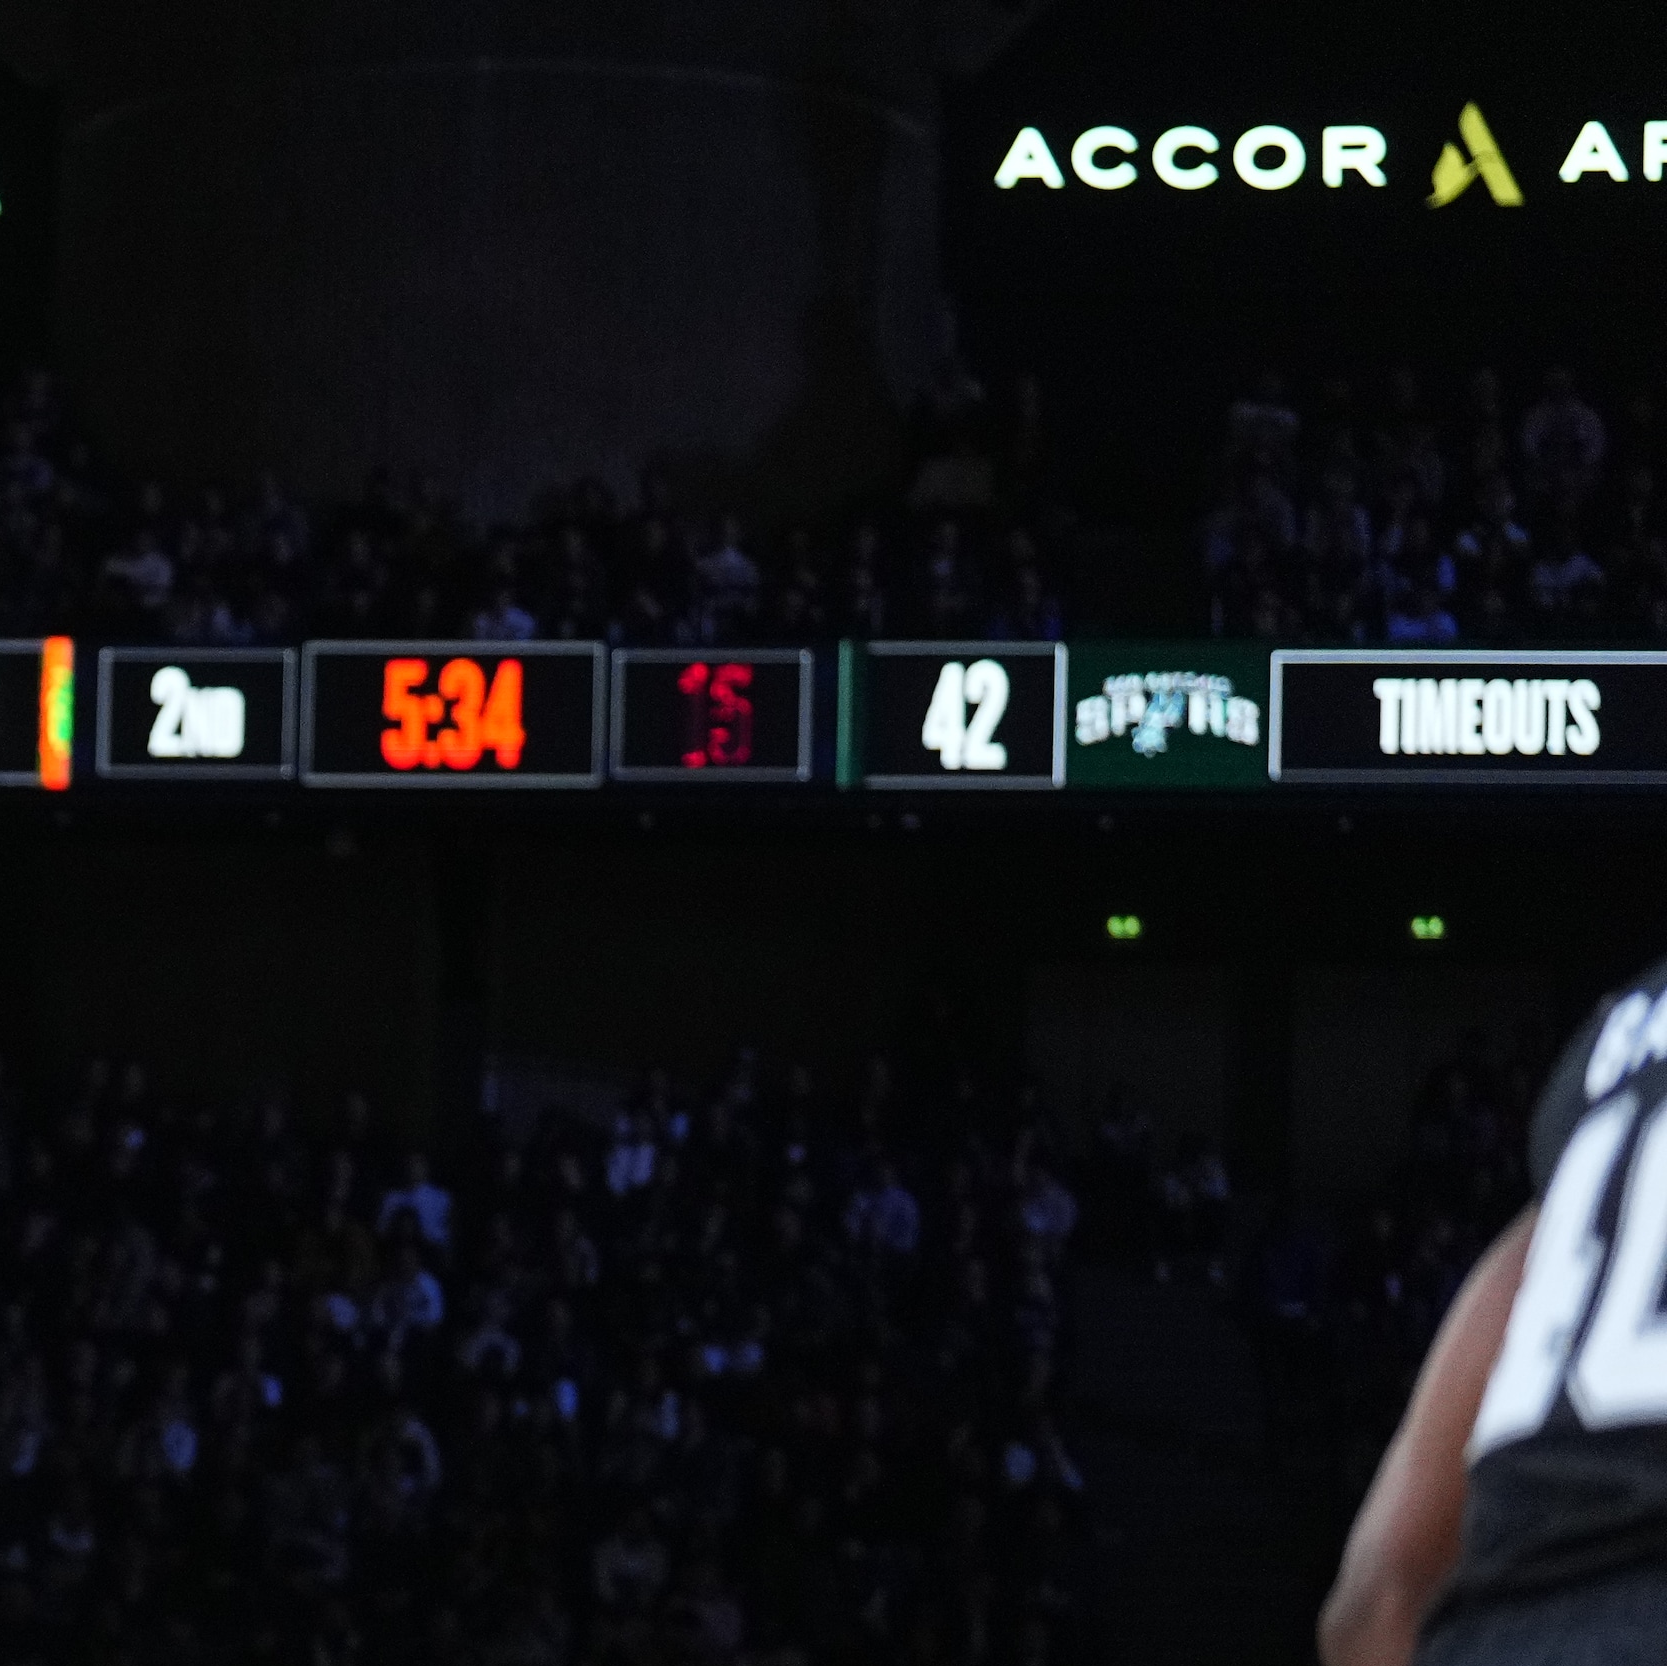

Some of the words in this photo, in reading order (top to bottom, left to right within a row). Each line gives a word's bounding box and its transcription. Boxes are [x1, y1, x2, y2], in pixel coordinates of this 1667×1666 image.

[994, 124, 1387, 190] ACCOR
[380, 657, 527, 770] 5:34
[921, 658, 1010, 770] 42
[1372, 677, 1601, 756] TIMEOUTS
